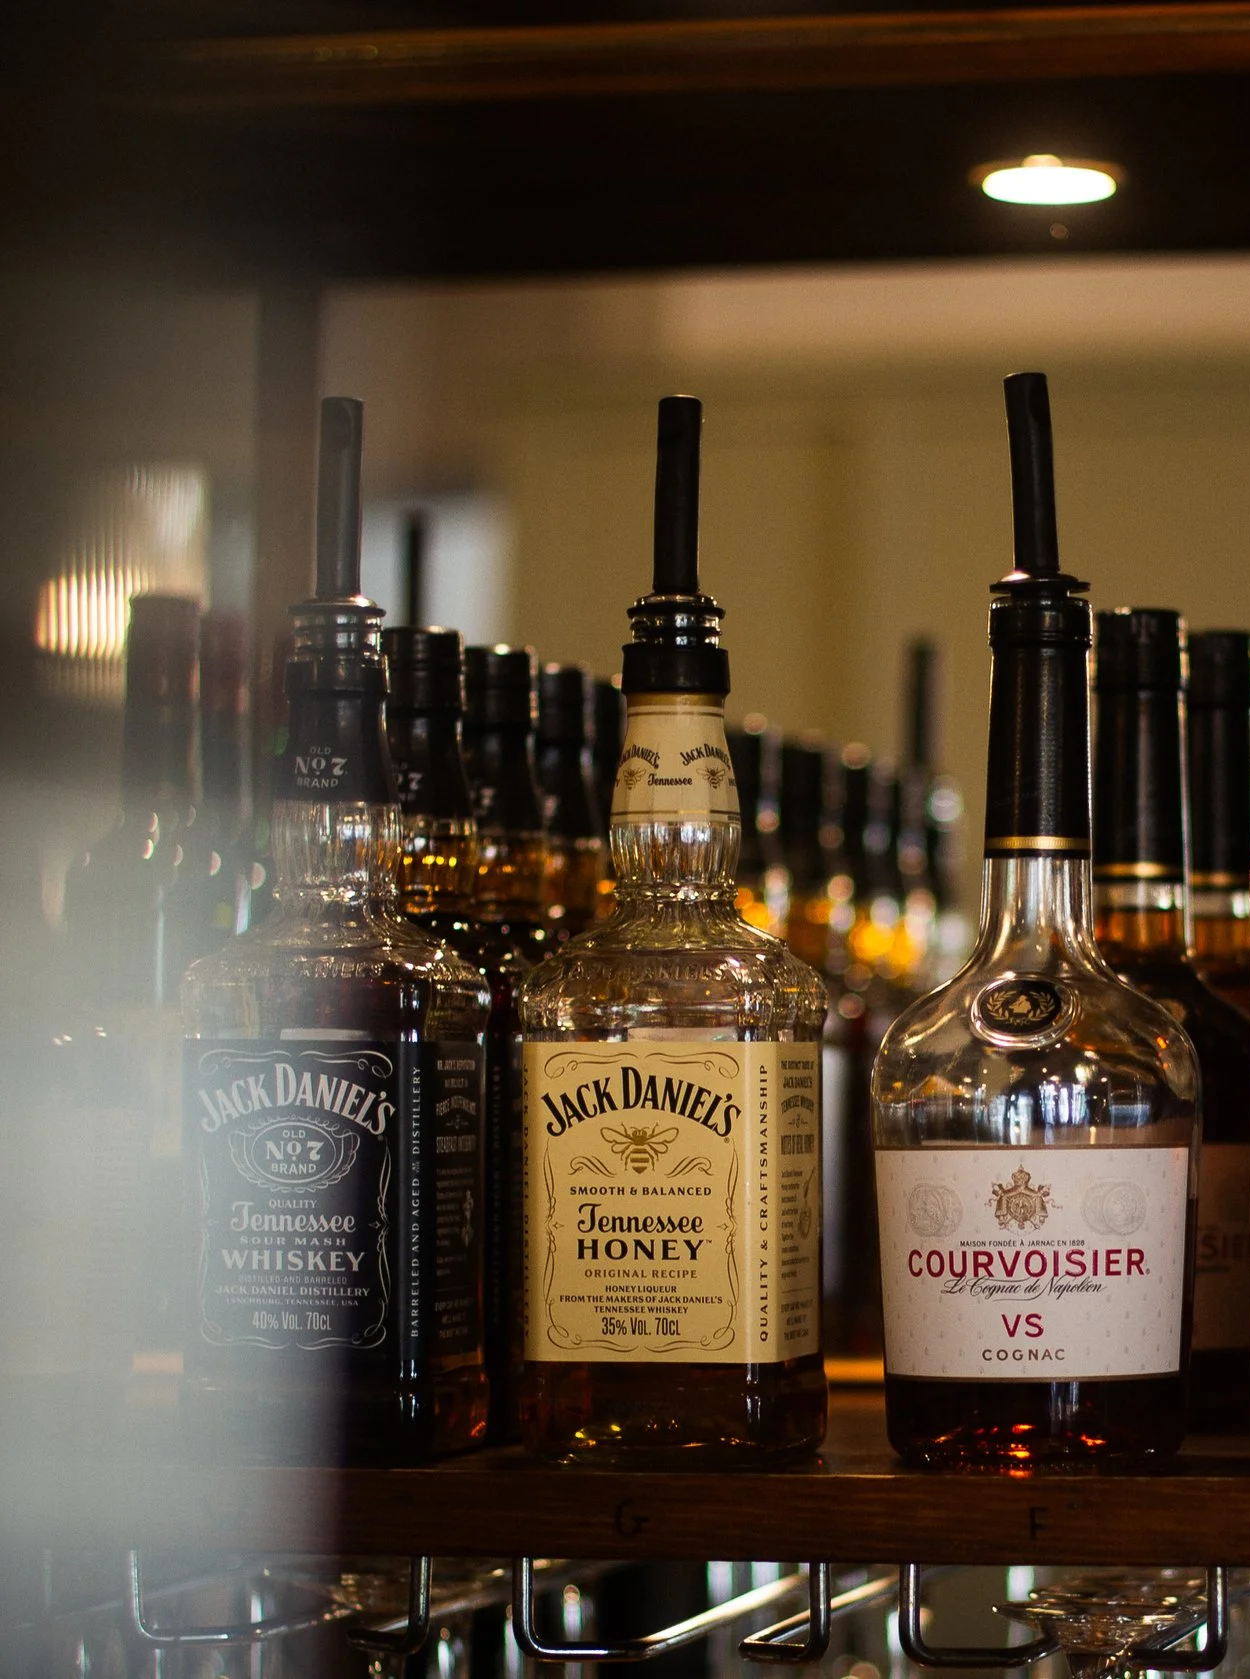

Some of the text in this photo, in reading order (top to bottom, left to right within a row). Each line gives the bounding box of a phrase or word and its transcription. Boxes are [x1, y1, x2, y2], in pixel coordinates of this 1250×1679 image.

[310, 747, 332, 755] OLD
[680, 747, 705, 766] JACK
[297, 777, 340, 788] BRAND
[648, 773, 692, 786] Tennessee
[199, 1063, 396, 1135] JACK DANIEL'S
[540, 1066, 742, 1137] JACK DANIEL'S
[412, 1066, 421, 1155] DISTILLERY
[282, 1130, 306, 1138] OLD
[271, 1163, 317, 1174] BRAND
[411, 1178, 420, 1217] AGED
[570, 1186, 712, 1196] SMOOTH & BALANCED
[268, 1200, 318, 1209] QUALITY
[759, 1065, 769, 1342] QUALITY & CRAFTSMANSHIP
[230, 1202, 356, 1233] Tennessee
[577, 1203, 704, 1233] Tennessee
[240, 1236, 346, 1246] SOUR MASH
[411, 1223, 420, 1253] AND
[960, 1240, 986, 1248] MAISON
[1028, 1240, 1055, 1248] JARNAC
[576, 1238, 704, 1260] HONEY
[221, 1249, 366, 1271] WHISKEY
[908, 1249, 1146, 1278] COURVOISIER
[584, 1269, 698, 1279] ORIGINAL RECIPE
[251, 1286, 298, 1296] DANIEL
[300, 1287, 370, 1297] DISTILLERY
[605, 1285, 678, 1294] HONEY LIQUEUR
[1023, 1279, 1042, 1294] de
[411, 1259, 420, 1337] BARRELED
[605, 1295, 643, 1303] MAKERS
[658, 1296, 682, 1304] JACK
[682, 1296, 724, 1304] DANIEL'S
[594, 1305, 689, 1315] TENNESSEE WHISKEY
[252, 1311, 279, 1330] 40%
[601, 1316, 628, 1336] 35%
[1001, 1313, 1044, 1338] VS
[981, 1349, 1065, 1361] COGNAC
